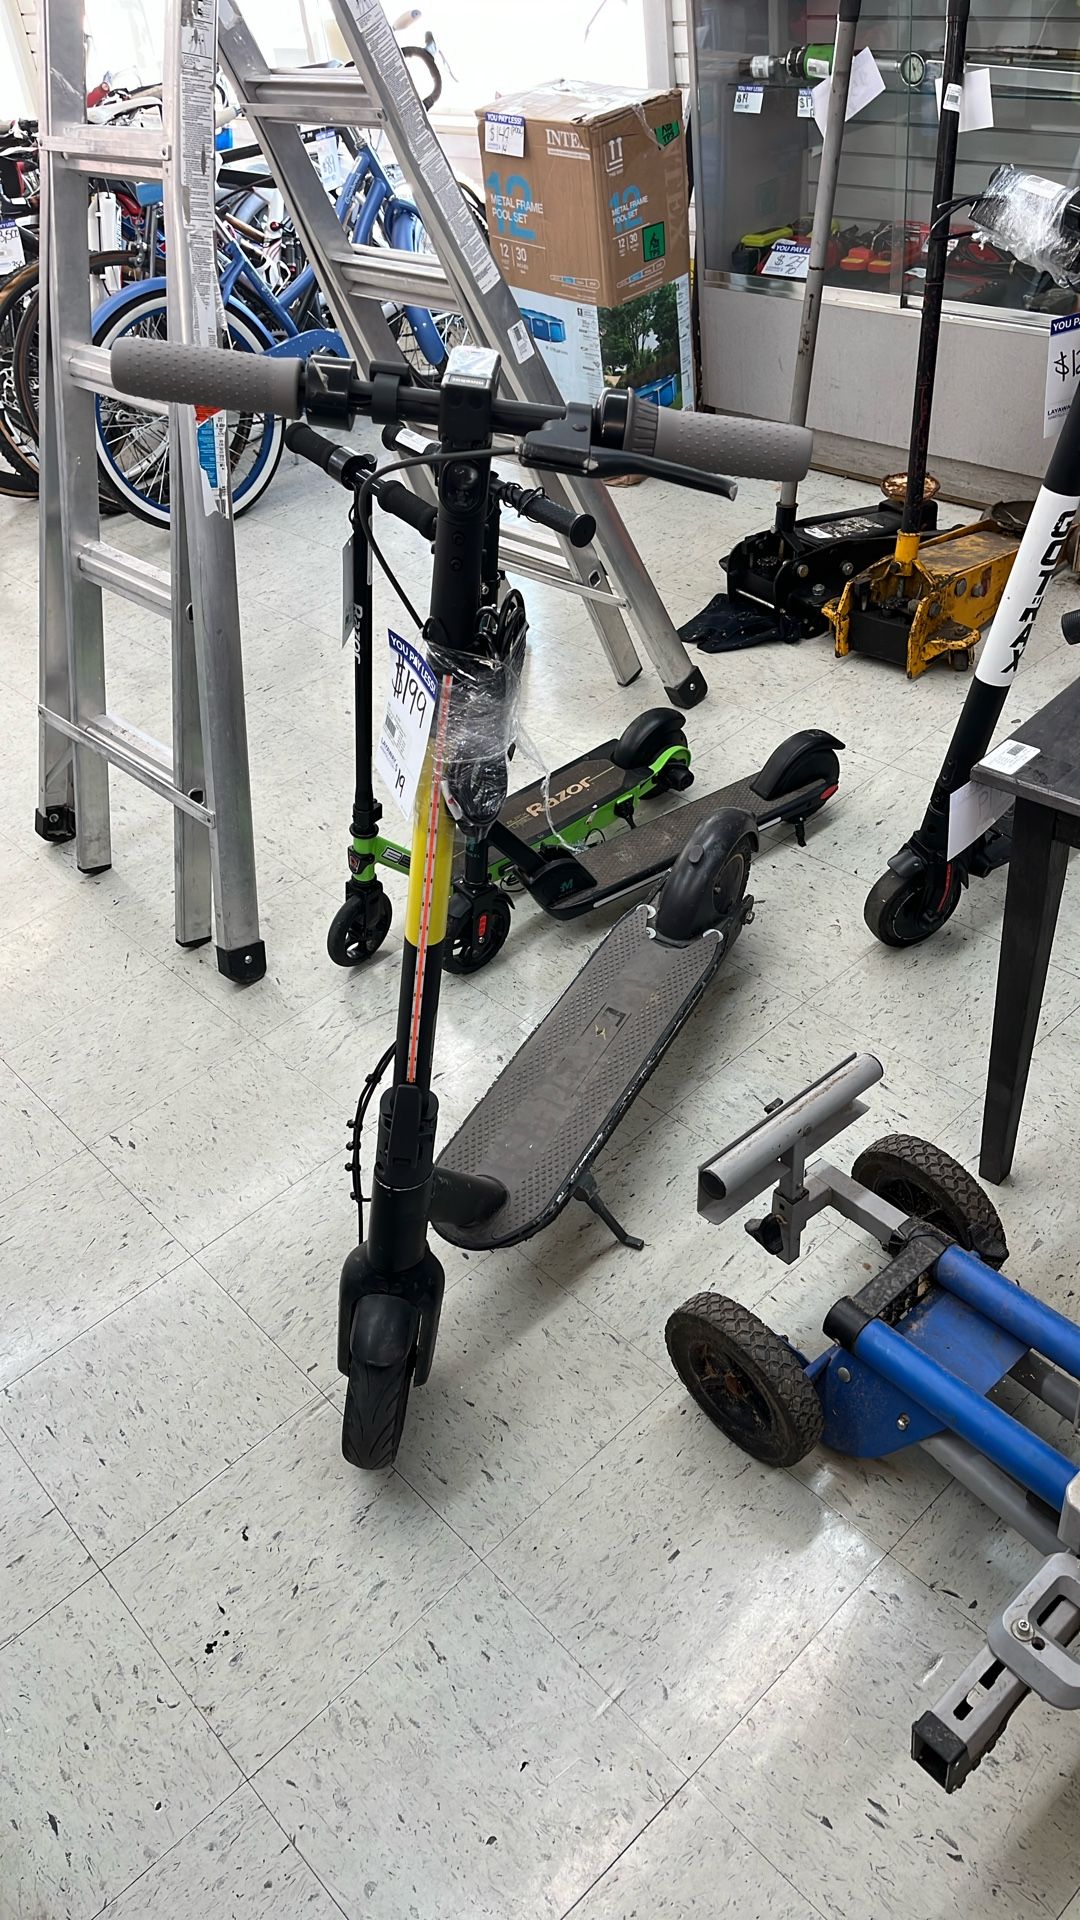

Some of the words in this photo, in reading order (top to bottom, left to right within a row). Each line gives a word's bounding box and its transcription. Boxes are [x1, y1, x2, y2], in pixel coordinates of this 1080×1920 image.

[487, 113, 498, 121] YOU
[545, 128, 590, 150] INTE
[485, 170, 536, 241] 12
[491, 194, 514, 208] METAL
[516, 198, 543, 214] FRAME
[609, 184, 643, 234] 12
[612, 202, 629, 217] METAL
[630, 195, 648, 208] FRAME
[492, 207, 513, 222] POOL
[514, 213, 527, 224] SET
[613, 214, 627, 225] POOL
[628, 208, 638, 220] SET
[618, 238, 625, 248] 12
[630, 232, 638, 243] 30
[500, 242, 509, 258] 12
[516, 246, 527, 261] 30
[1053, 320, 1072, 332] YOU
[1048, 404, 1071, 416] LAYAWA
[1001, 509, 1077, 673] GOTRAX
[354, 602, 364, 665] Razor
[390, 634, 409, 656] YOU
[409, 652, 422, 671] PAY
[421, 666, 436, 693] LESS!
[392, 653, 427, 729] $199
[395, 768, 406, 798] 19
[526, 776, 590, 817] Razor
